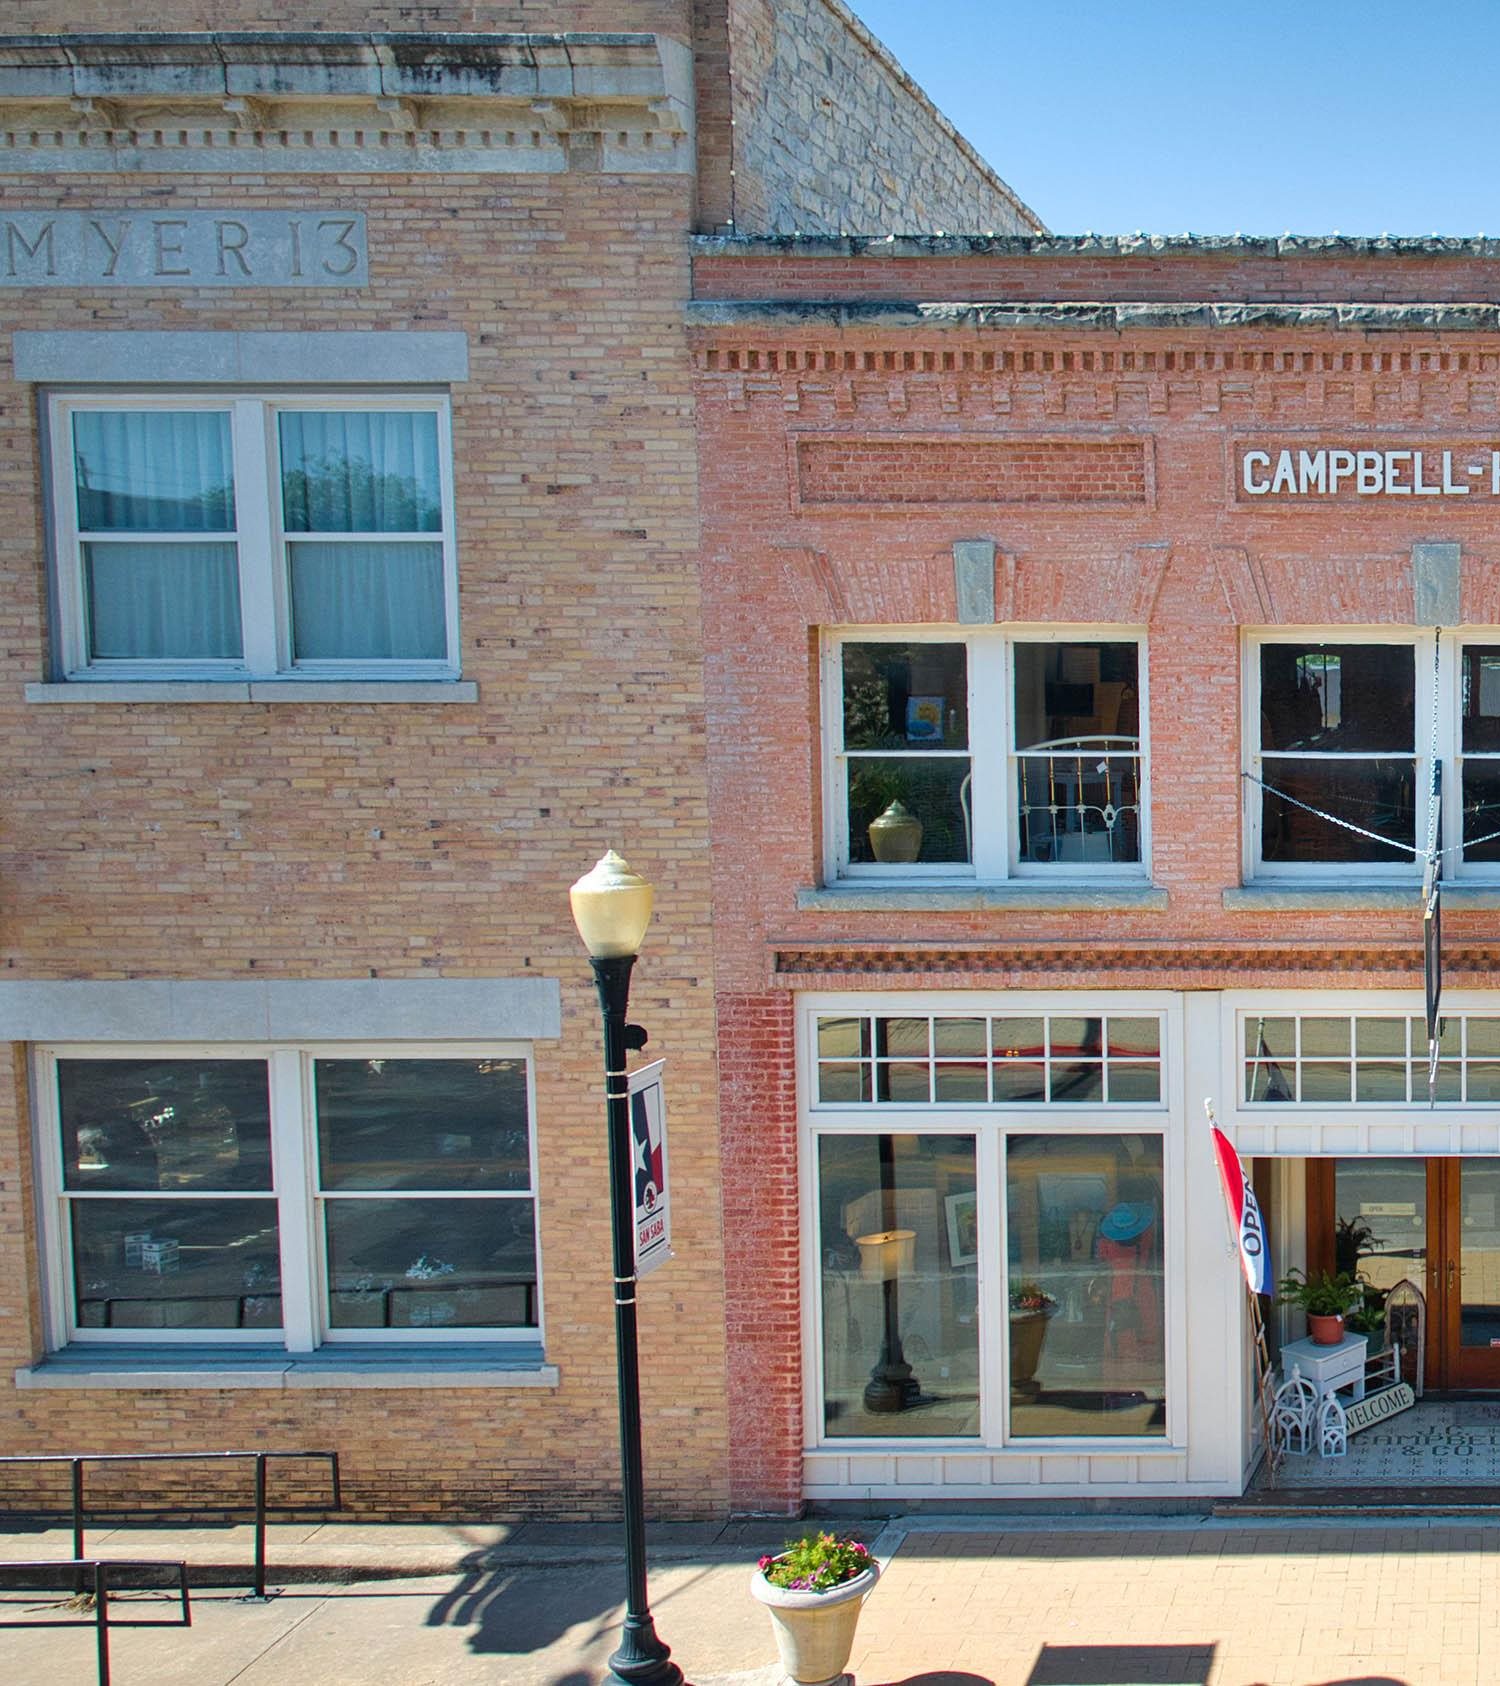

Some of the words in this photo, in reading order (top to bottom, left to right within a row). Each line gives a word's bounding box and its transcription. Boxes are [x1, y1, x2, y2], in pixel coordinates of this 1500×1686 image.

[5, 220, 252, 277] MYER
[288, 220, 357, 277] 13
[639, 1225, 651, 1247] SAN
[650, 1218, 664, 1239] SABA
[1401, 1445, 1424, 1457] &
